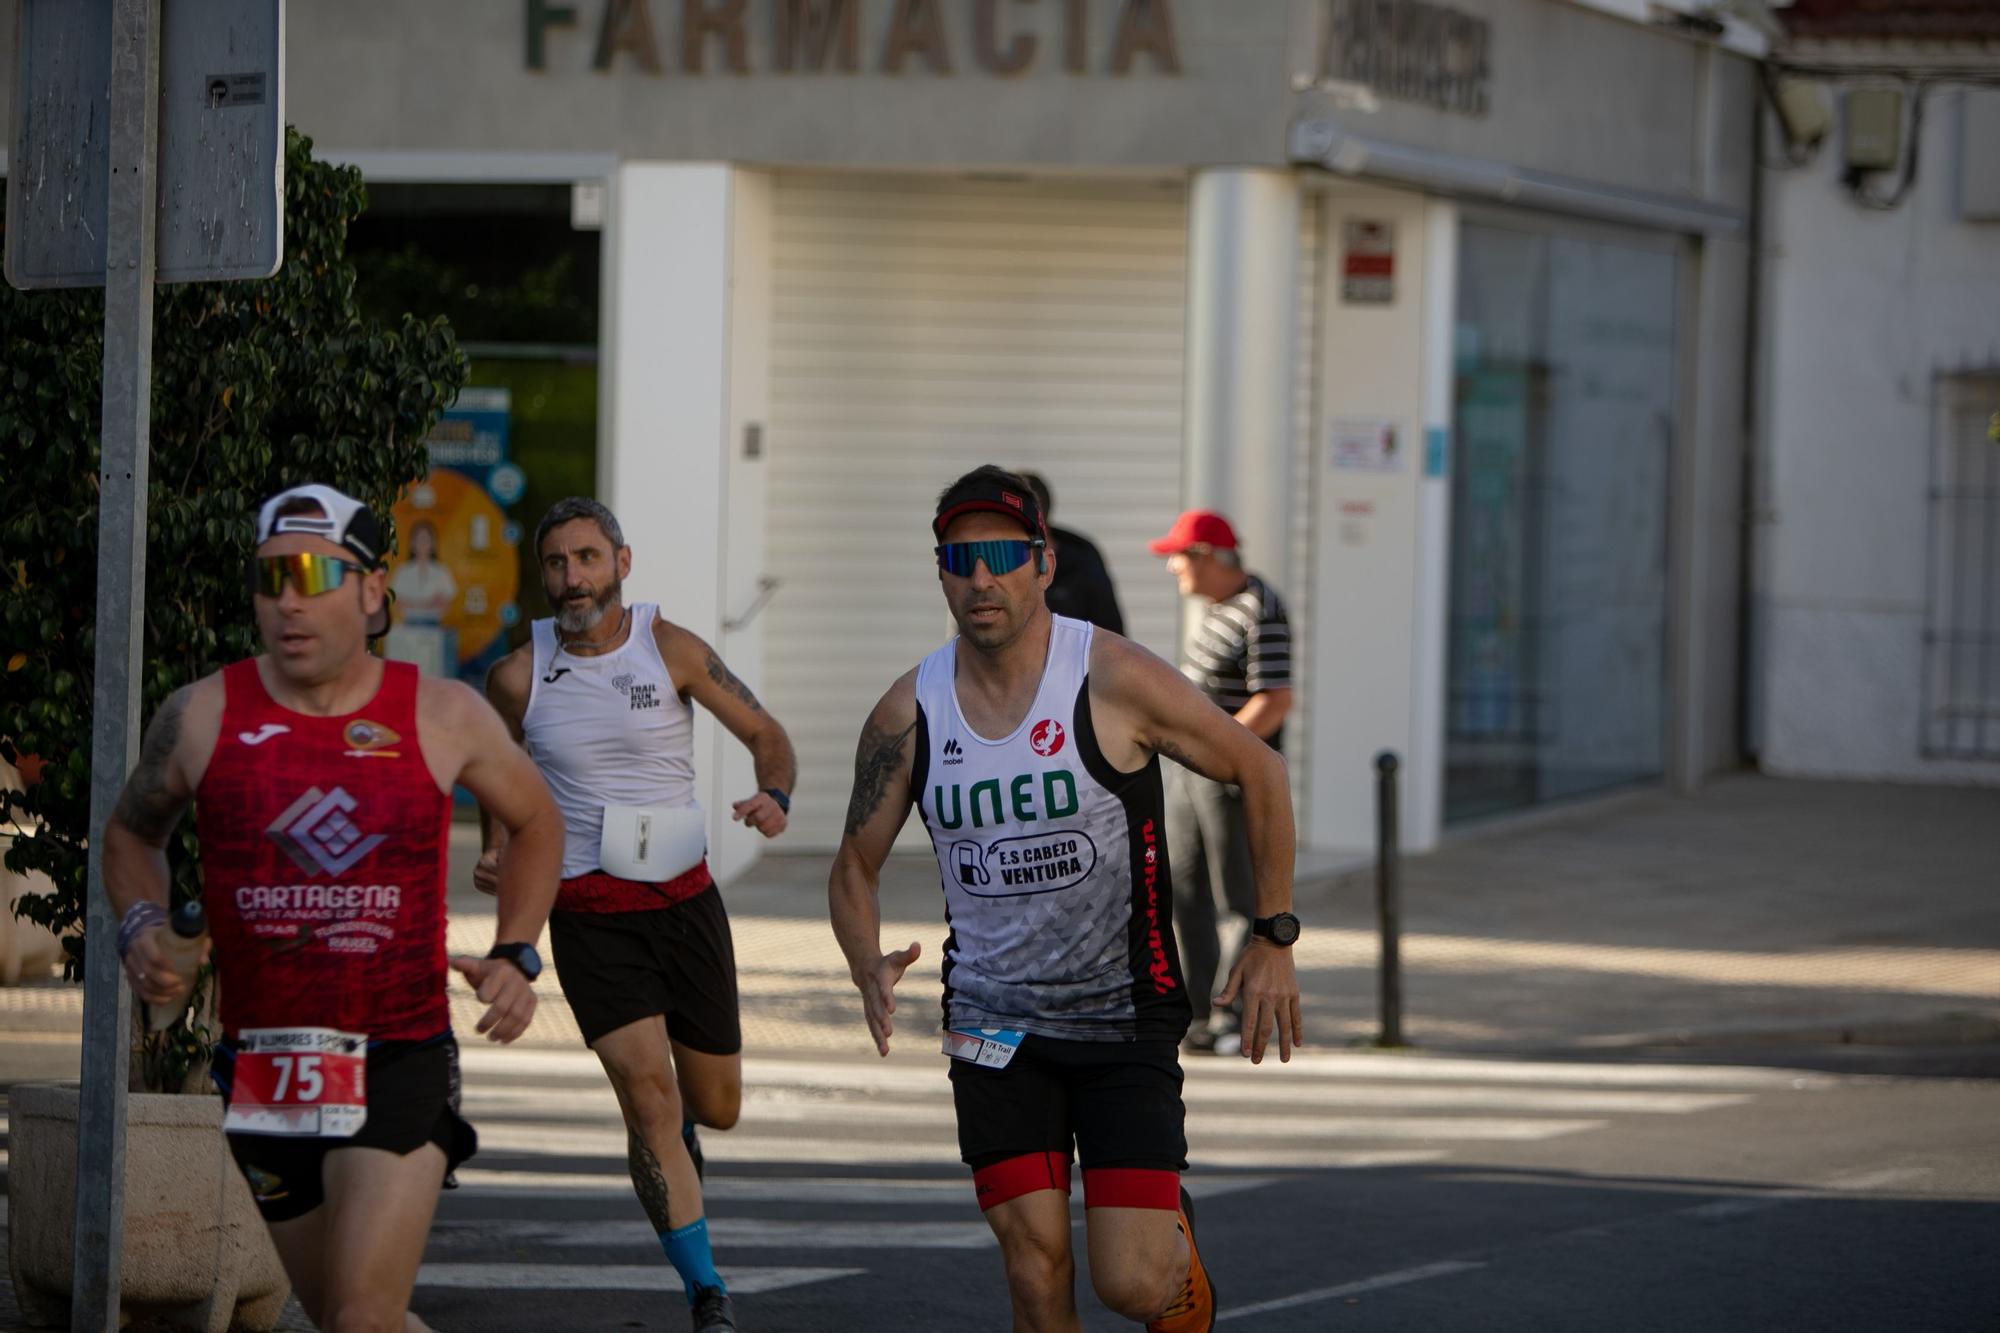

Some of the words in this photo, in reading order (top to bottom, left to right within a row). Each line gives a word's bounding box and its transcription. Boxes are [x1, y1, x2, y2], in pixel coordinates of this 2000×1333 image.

[524, 0, 1184, 74] FARMACIA
[630, 699, 660, 711] FEVER
[943, 758, 963, 766] mobel
[935, 769, 1079, 830] UNED
[1023, 839, 1077, 863] CABEZO
[1001, 857, 1081, 886] VENTURA
[236, 884, 402, 909] CARTAGENA
[362, 908, 398, 919] PVC
[997, 1044, 1012, 1055] Trail
[271, 1055, 324, 1102] 75
